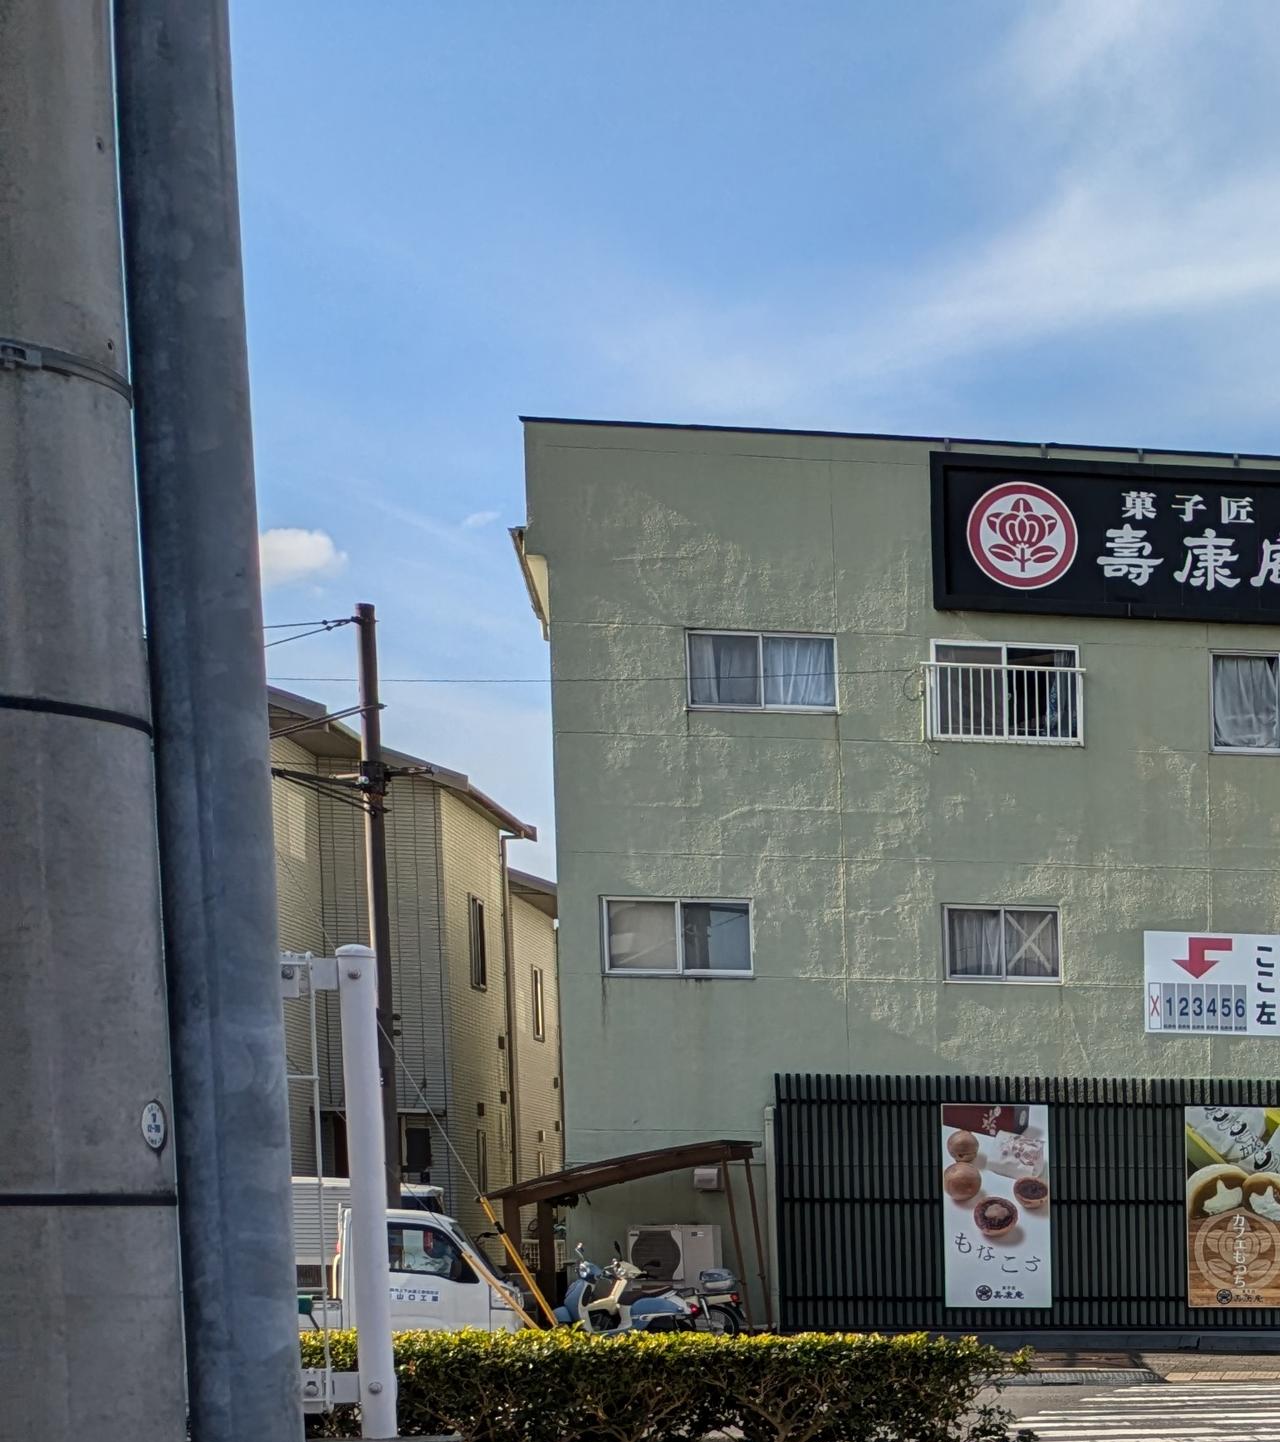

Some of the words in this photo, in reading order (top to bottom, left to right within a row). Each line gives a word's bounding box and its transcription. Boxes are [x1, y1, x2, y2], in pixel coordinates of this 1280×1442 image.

[1121, 490, 1255, 525] 菓子匠
[1256, 946, 1277, 1025] ここ左
[1231, 1213, 1247, 1289] カフェもっち
